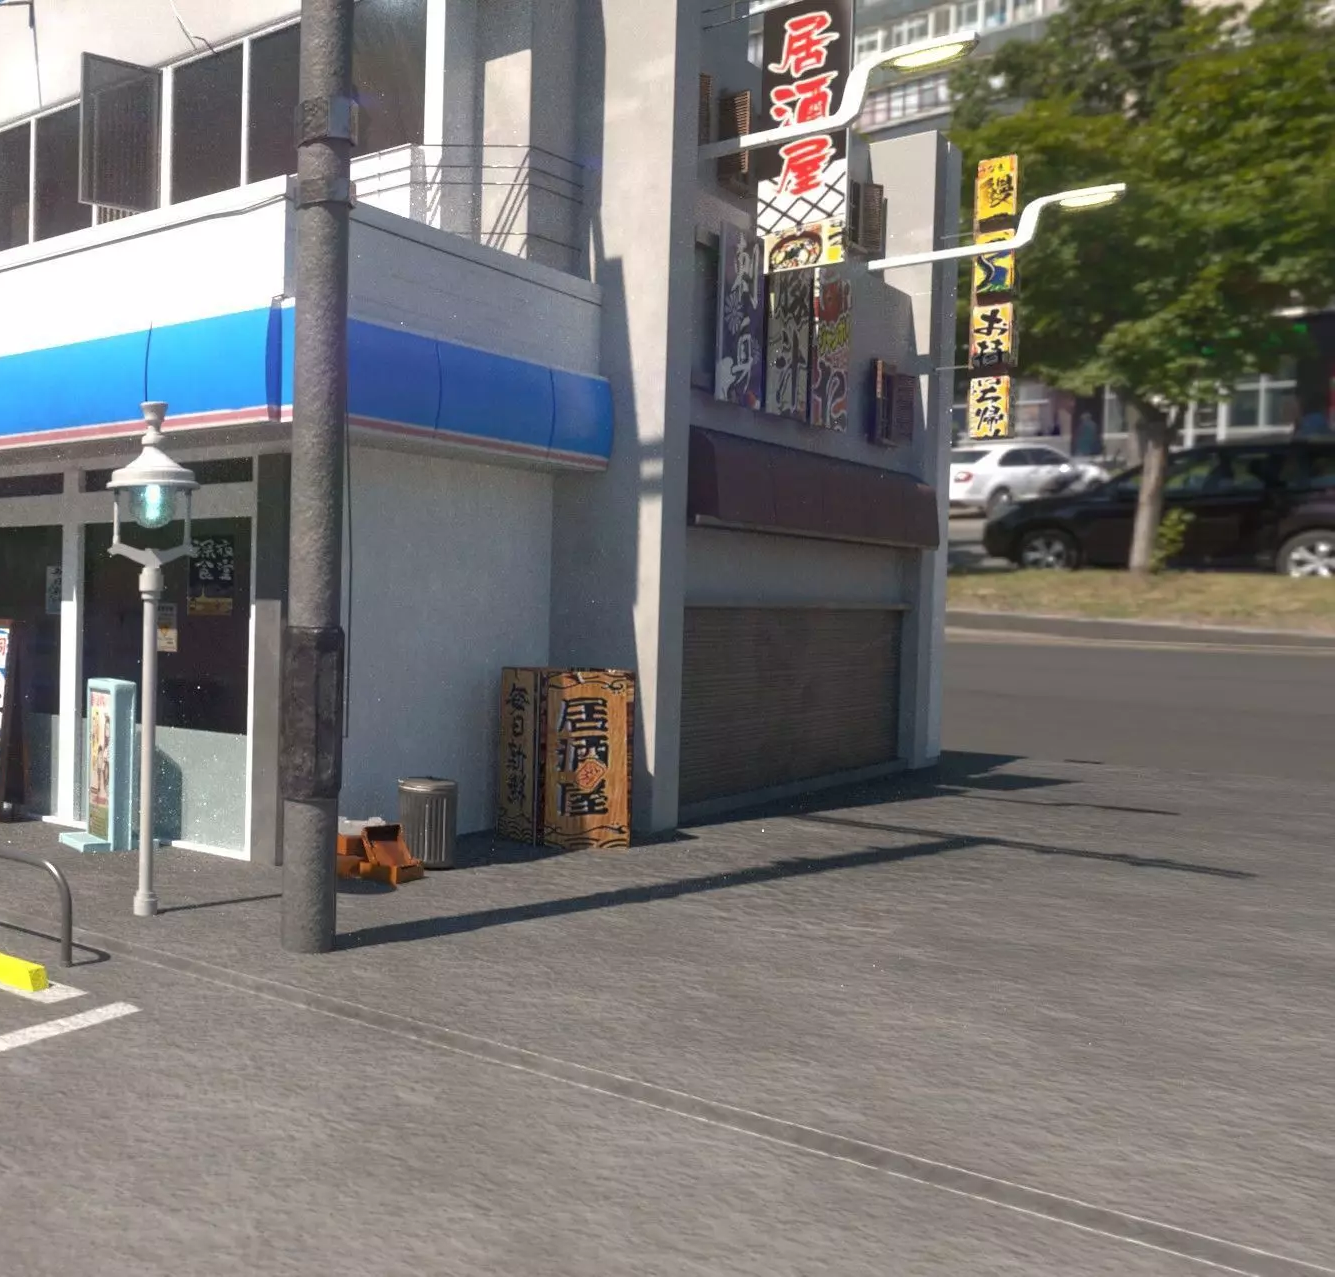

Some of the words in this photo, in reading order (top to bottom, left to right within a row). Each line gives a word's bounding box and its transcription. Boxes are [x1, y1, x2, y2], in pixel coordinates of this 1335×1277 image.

[768, 11, 840, 196] 居酒屋
[731, 232, 760, 396] 刺身
[556, 697, 609, 817] 居酒屋
